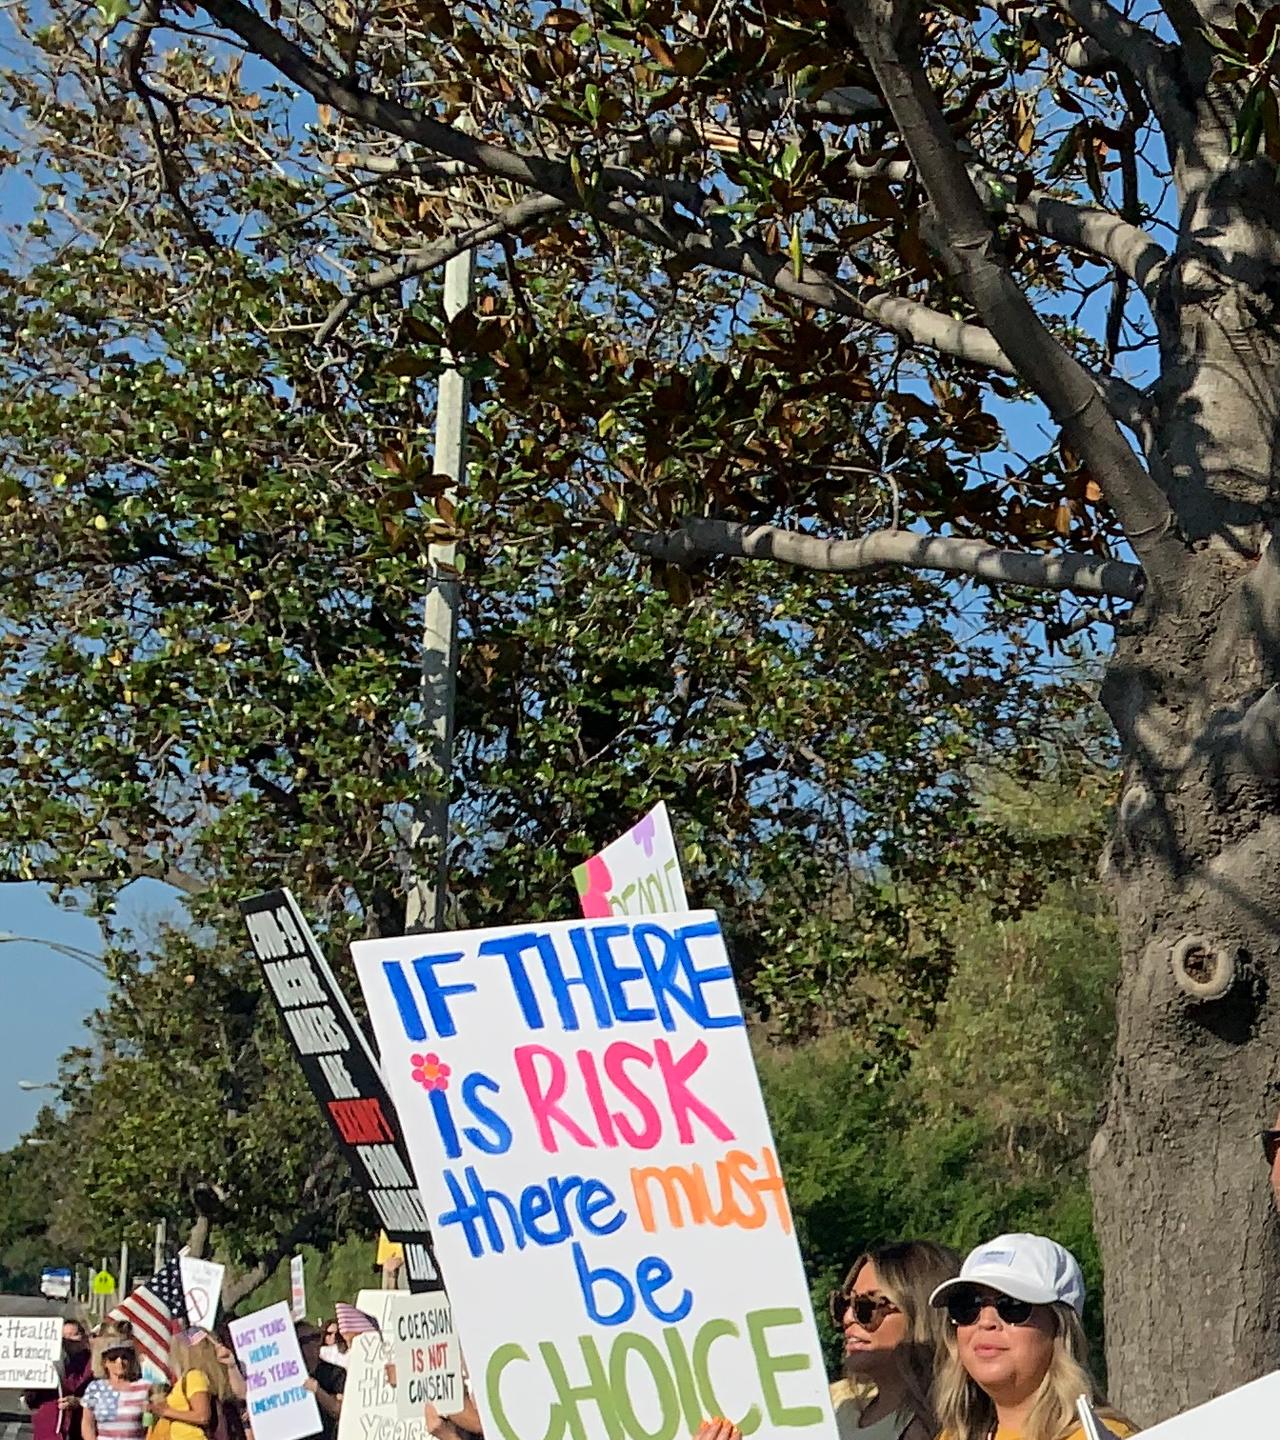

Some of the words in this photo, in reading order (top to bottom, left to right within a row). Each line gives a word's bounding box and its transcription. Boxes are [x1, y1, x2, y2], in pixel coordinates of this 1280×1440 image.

[382, 951, 477, 1042] IF
[478, 921, 744, 1032] THERE
[514, 1038, 737, 1153] RISK
[438, 1165, 627, 1258] there
[630, 1146, 791, 1235] must
[572, 1242, 693, 1326] be
[7, 1319, 58, 1340] Health
[411, 1347, 425, 1373] IS
[429, 1342, 449, 1371] NOT
[408, 1373, 456, 1403] CONSENT
